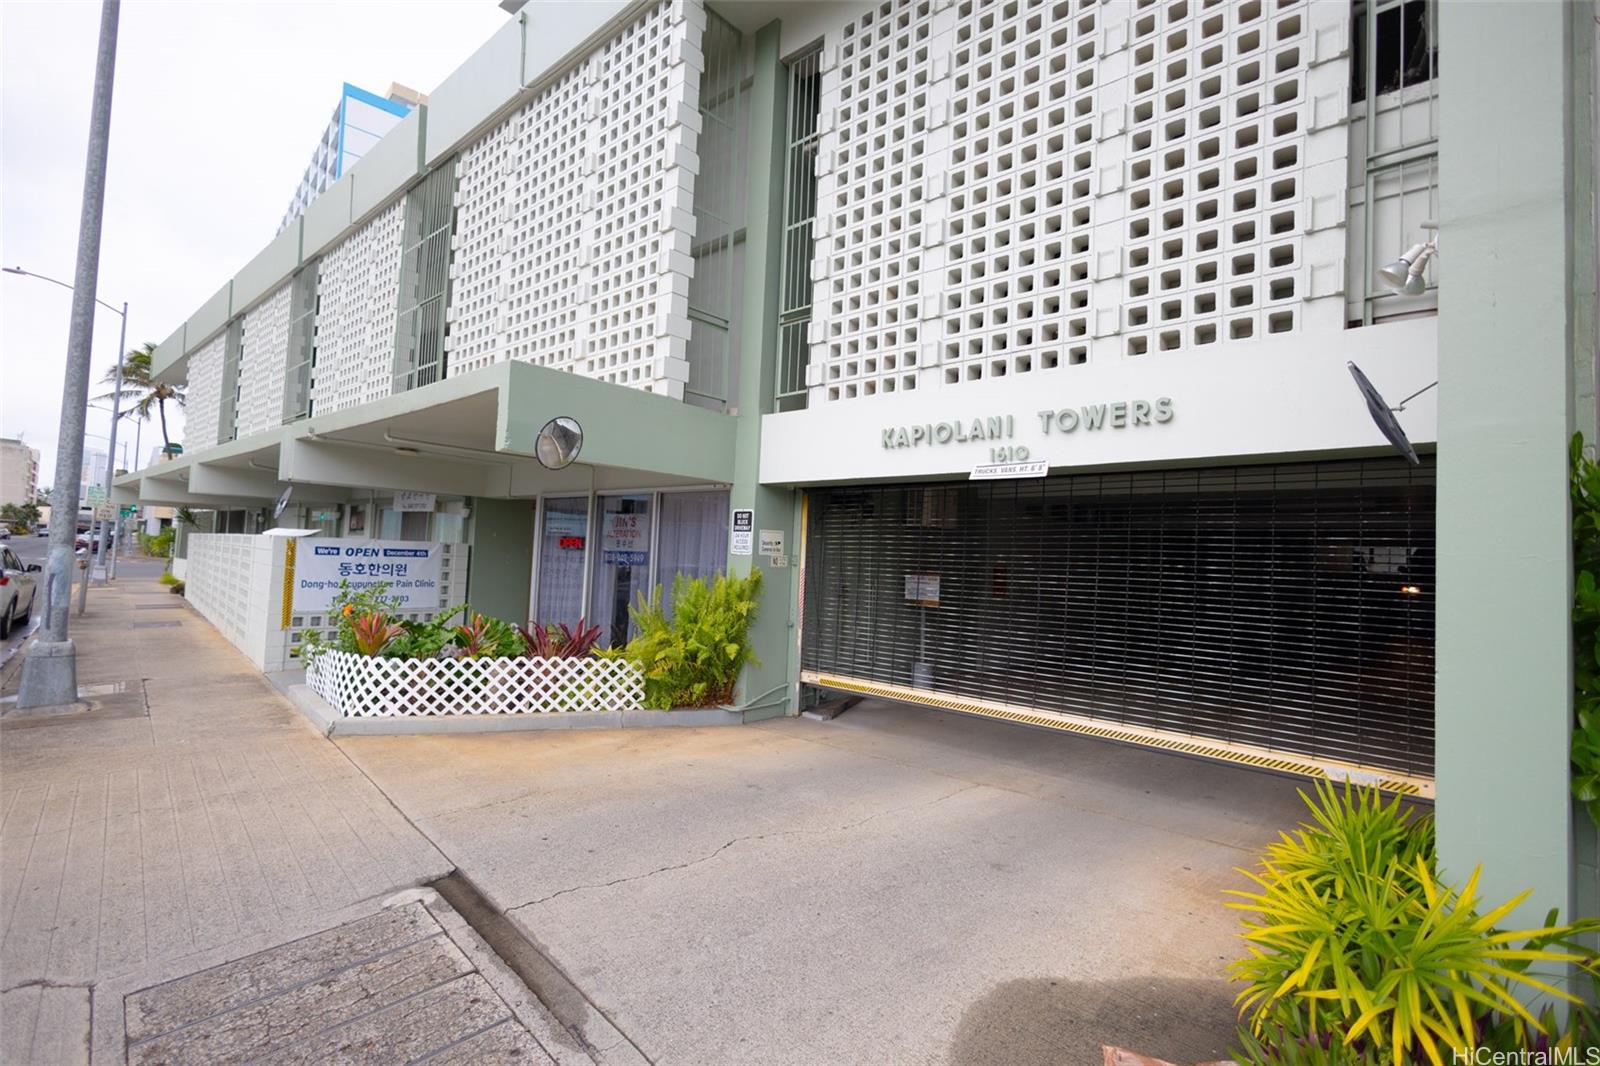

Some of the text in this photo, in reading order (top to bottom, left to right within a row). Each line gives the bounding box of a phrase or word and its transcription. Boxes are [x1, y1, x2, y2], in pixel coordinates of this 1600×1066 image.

[881, 397, 1175, 450] KAPIOLANI TOWERS
[990, 446, 1030, 463] 1610
[317, 547, 338, 555] We're
[345, 547, 380, 557] OPEN
[338, 562, 408, 577] 동호한의원
[301, 579, 338, 590] Dong-ho
[396, 580, 413, 588] Pain
[414, 579, 435, 588] Clinic
